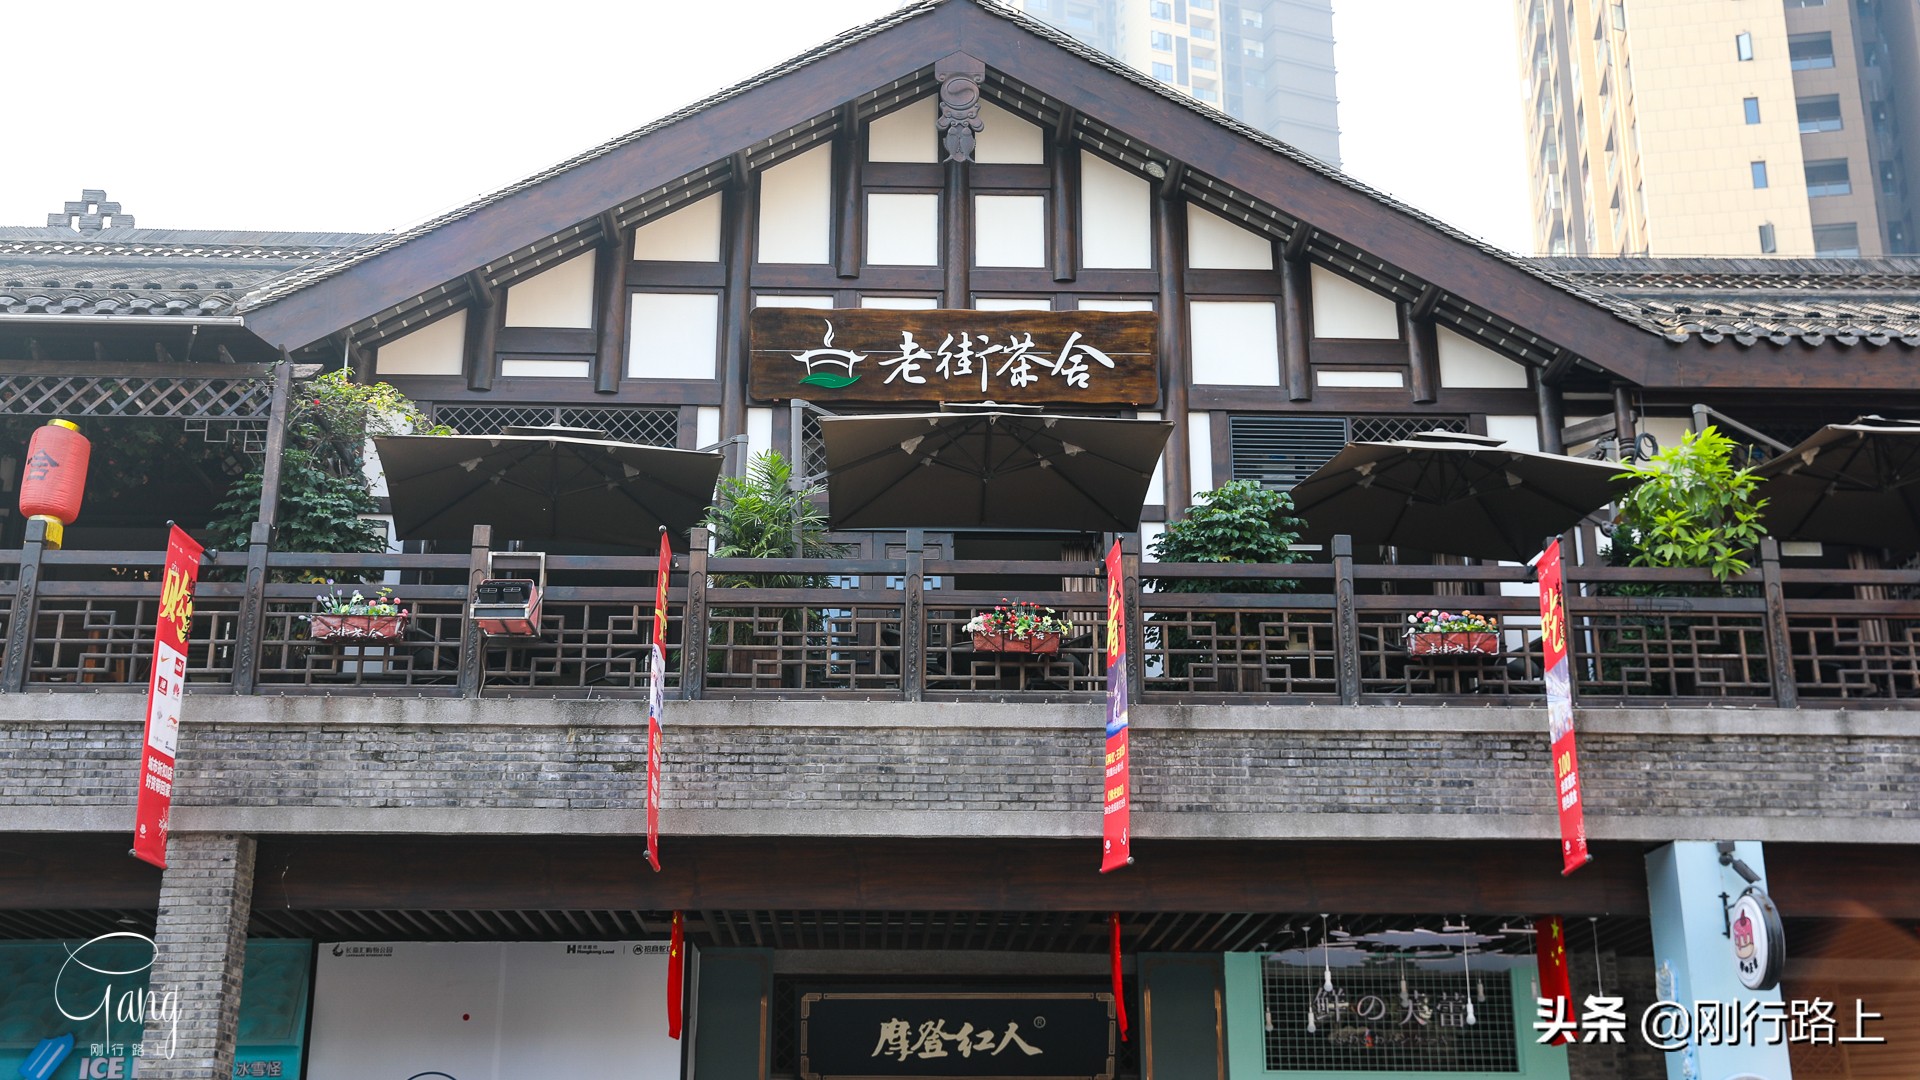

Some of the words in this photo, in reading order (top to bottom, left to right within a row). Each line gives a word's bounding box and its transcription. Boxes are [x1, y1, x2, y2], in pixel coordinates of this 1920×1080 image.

[878, 331, 1115, 392] 老街茶舍
[1558, 750, 1572, 779] 100
[145, 773, 171, 798] 好货带回家
[871, 1017, 1043, 1062] 摩登红人
[78, 1057, 125, 1080] ICE
[235, 1061, 283, 1078] 冰雪怪
